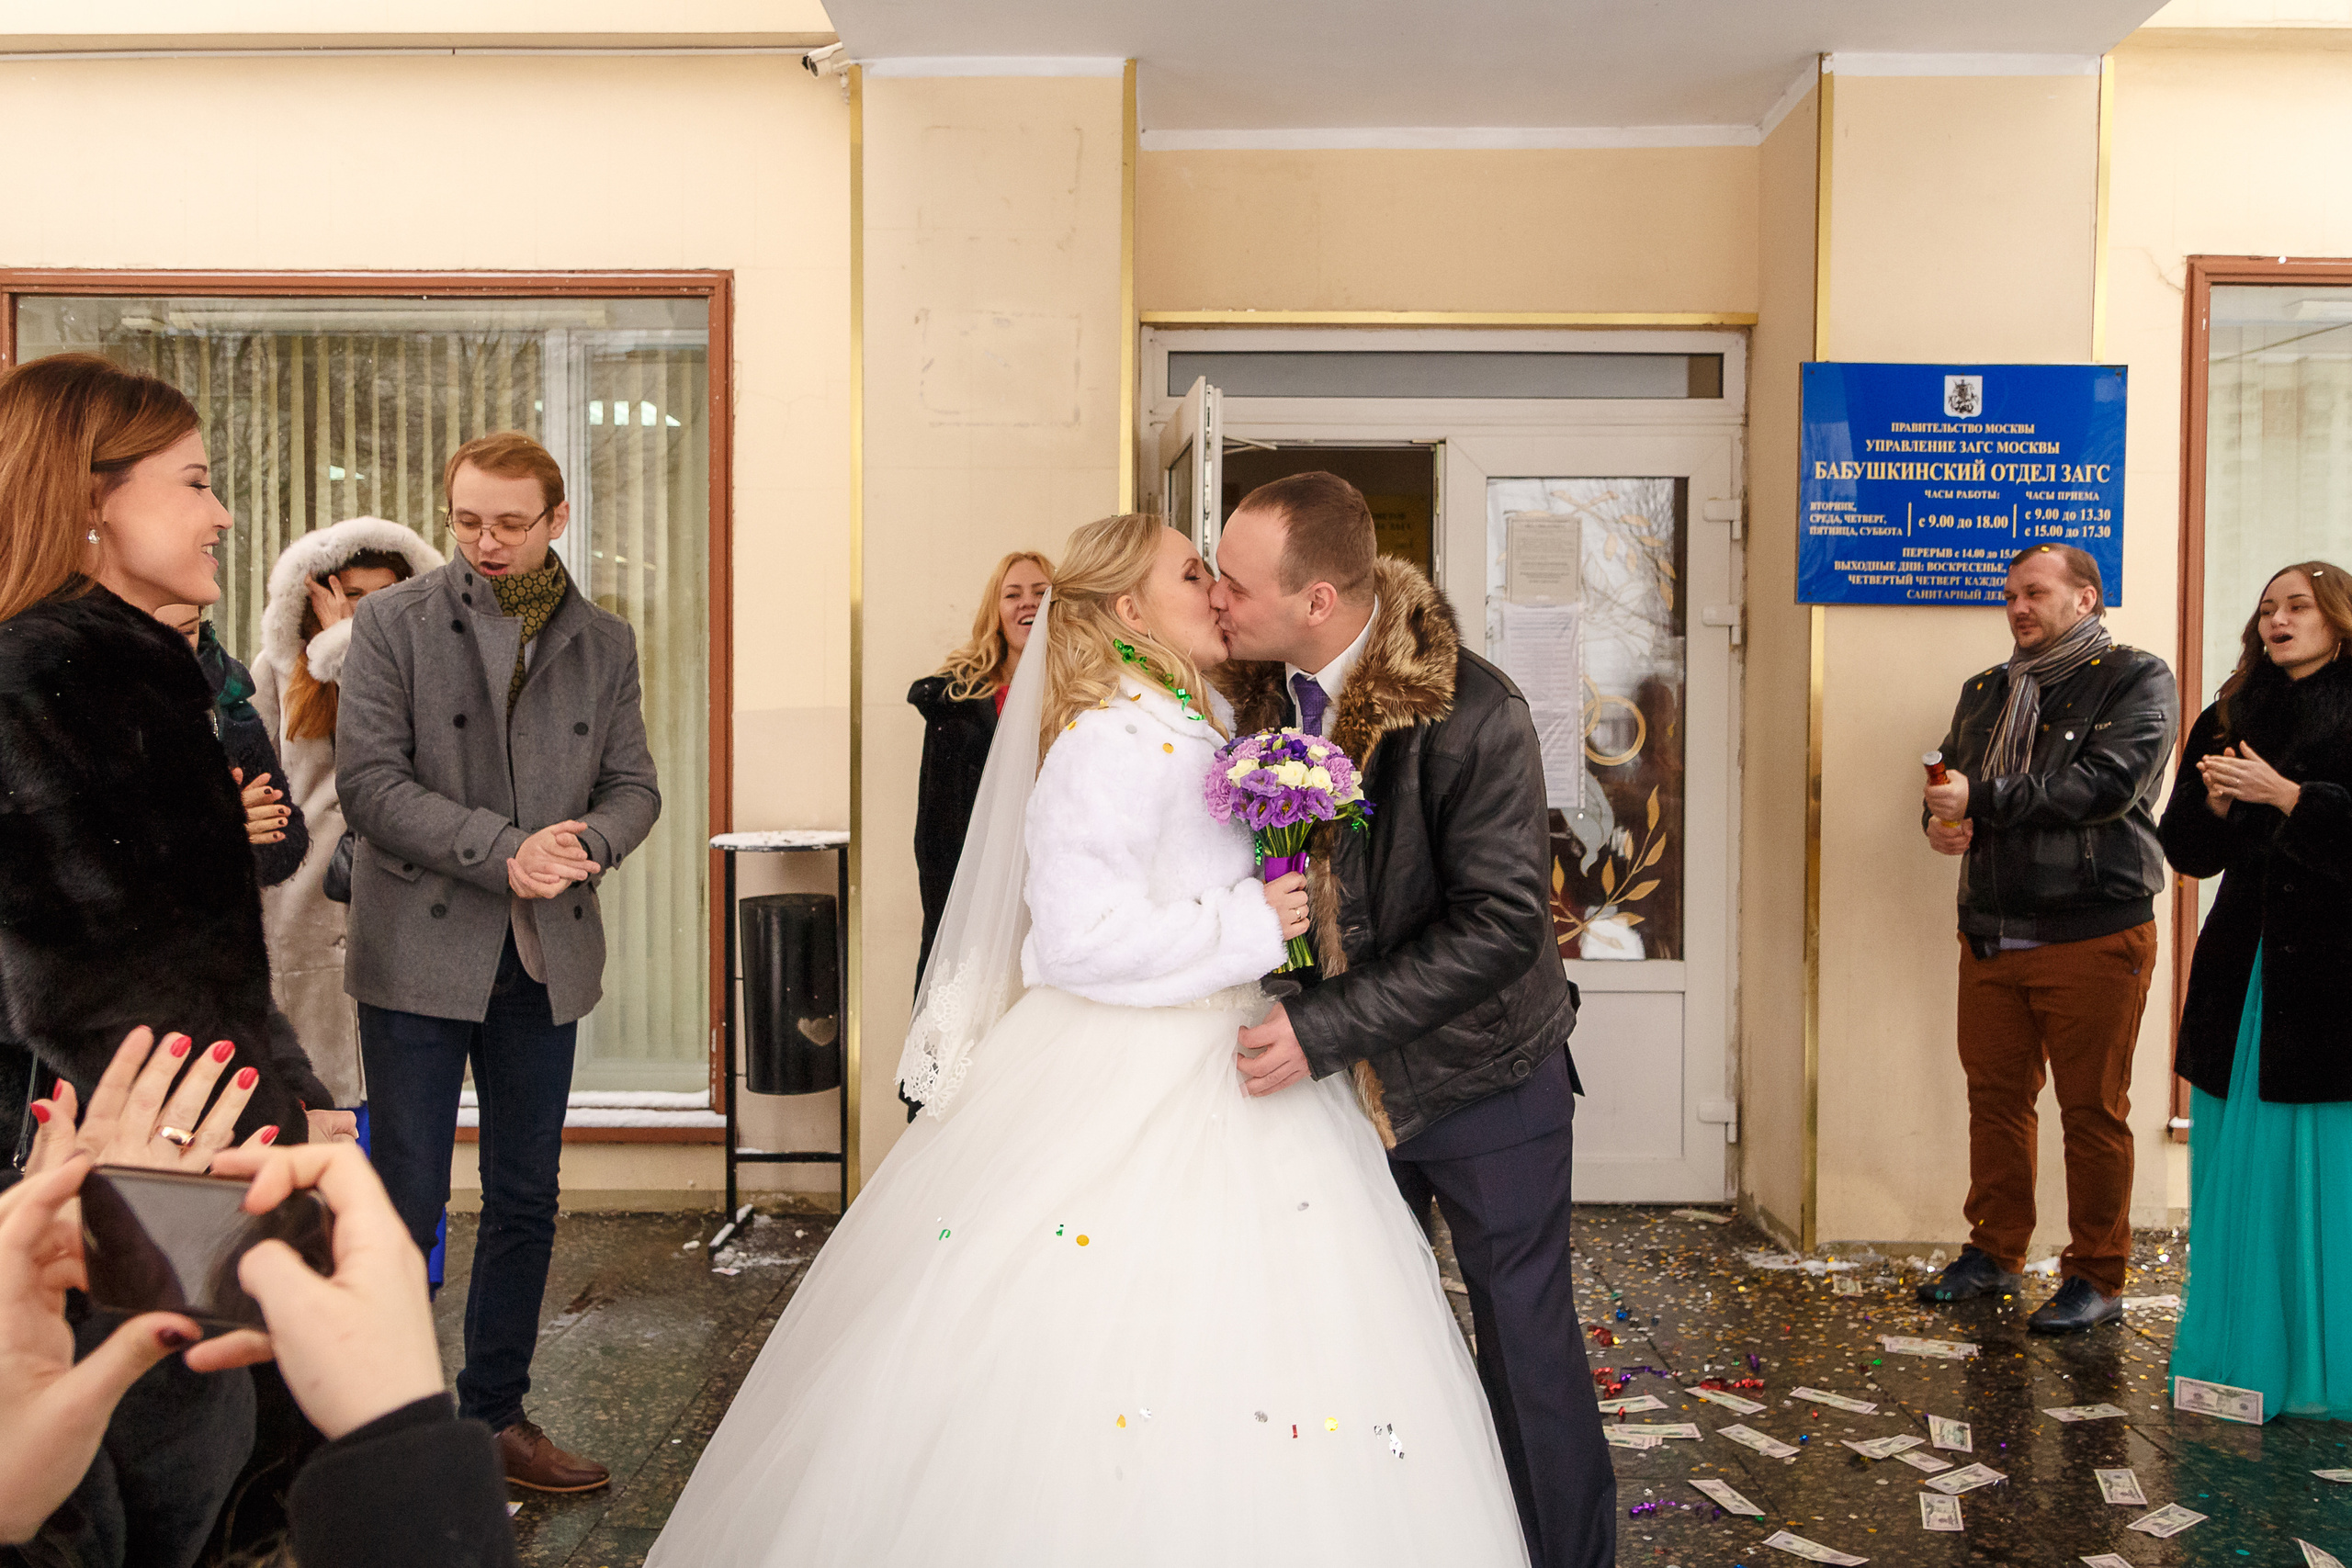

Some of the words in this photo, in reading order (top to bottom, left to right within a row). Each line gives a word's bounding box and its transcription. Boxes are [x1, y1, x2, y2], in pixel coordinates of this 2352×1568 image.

[1891, 422, 1983, 434] ПРАВИТЕЛЬСТВО
[1984, 423, 2035, 434] МОСКВЫ
[1866, 439, 1956, 453] УПРАВЛЕНИЕ
[1959, 441, 1994, 454] ЗАГС
[1996, 441, 2060, 455] МОСКВЫ
[1815, 458, 1985, 481] БАБУШКИНСКИЙ
[1990, 463, 2056, 485] ОТДЕЛ
[2061, 464, 2110, 483] ЗАГС
[1924, 489, 1954, 499] ЧАСЫ
[1956, 490, 2000, 500] РАБОТЫ:
[2026, 491, 2055, 500] ЧАСЫ
[2057, 491, 2099, 501] ПРИЕМА
[2025, 511, 2031, 520] с
[2034, 508, 2060, 521] 9.00
[2062, 511, 2076, 521] до
[2080, 509, 2111, 521] 13.30
[1918, 517, 1926, 528] с
[1928, 513, 1955, 528] 9.00
[1957, 517, 1973, 529] до
[1976, 514, 2009, 529] 18.00
[1859, 526, 1903, 536] СУББОТА
[2024, 527, 2031, 536] с
[2034, 525, 2064, 537] 15.00
[2064, 527, 2079, 538] до
[2082, 525, 2111, 538] 17.30
[1902, 547, 1953, 558] ПЕРЕРЫВ
[1954, 550, 1960, 558] с
[1962, 547, 1985, 558] 14.00
[1986, 550, 1997, 559] до
[1834, 560, 1896, 571] ВЫХОДНЫЕ
[1897, 560, 1925, 572] ДНИ:
[1848, 574, 1913, 585] ЧЕТВЕРТЫЙ
[1916, 575, 1962, 585] ЧЕТВЕРГ
[1906, 589, 1981, 600] САНИТАРНЫЙ
[1984, 591, 2006, 601] ДЕН
